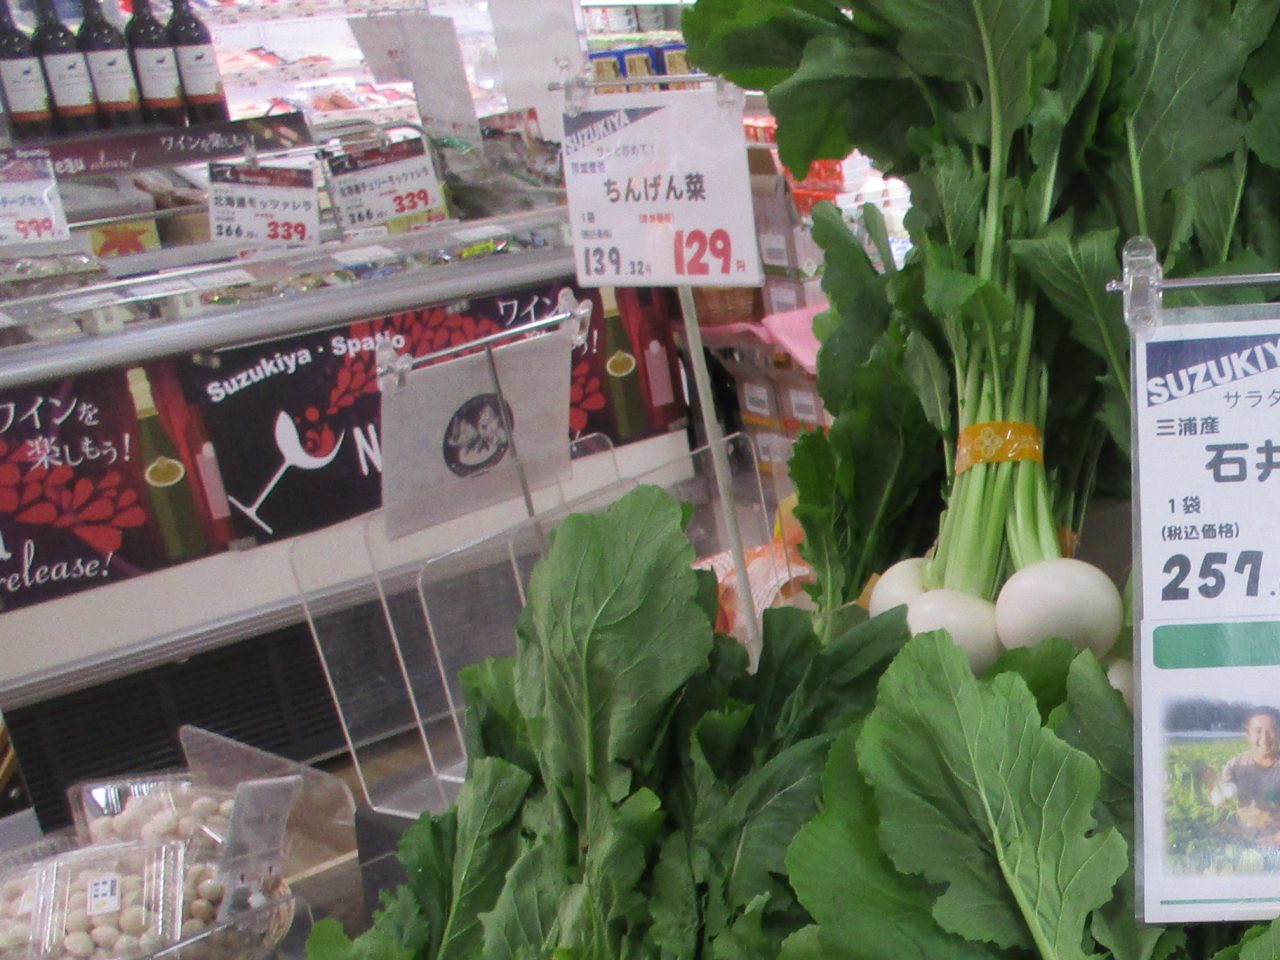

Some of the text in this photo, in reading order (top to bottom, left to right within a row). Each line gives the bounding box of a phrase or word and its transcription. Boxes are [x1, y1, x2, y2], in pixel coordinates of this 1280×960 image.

[604, 173, 706, 203] ちんげん菜
[207, 344, 313, 404] Suzukiya
[1155, 416, 1221, 437] 三浦産
[1161, 522, 1240, 542] (税込価格)
